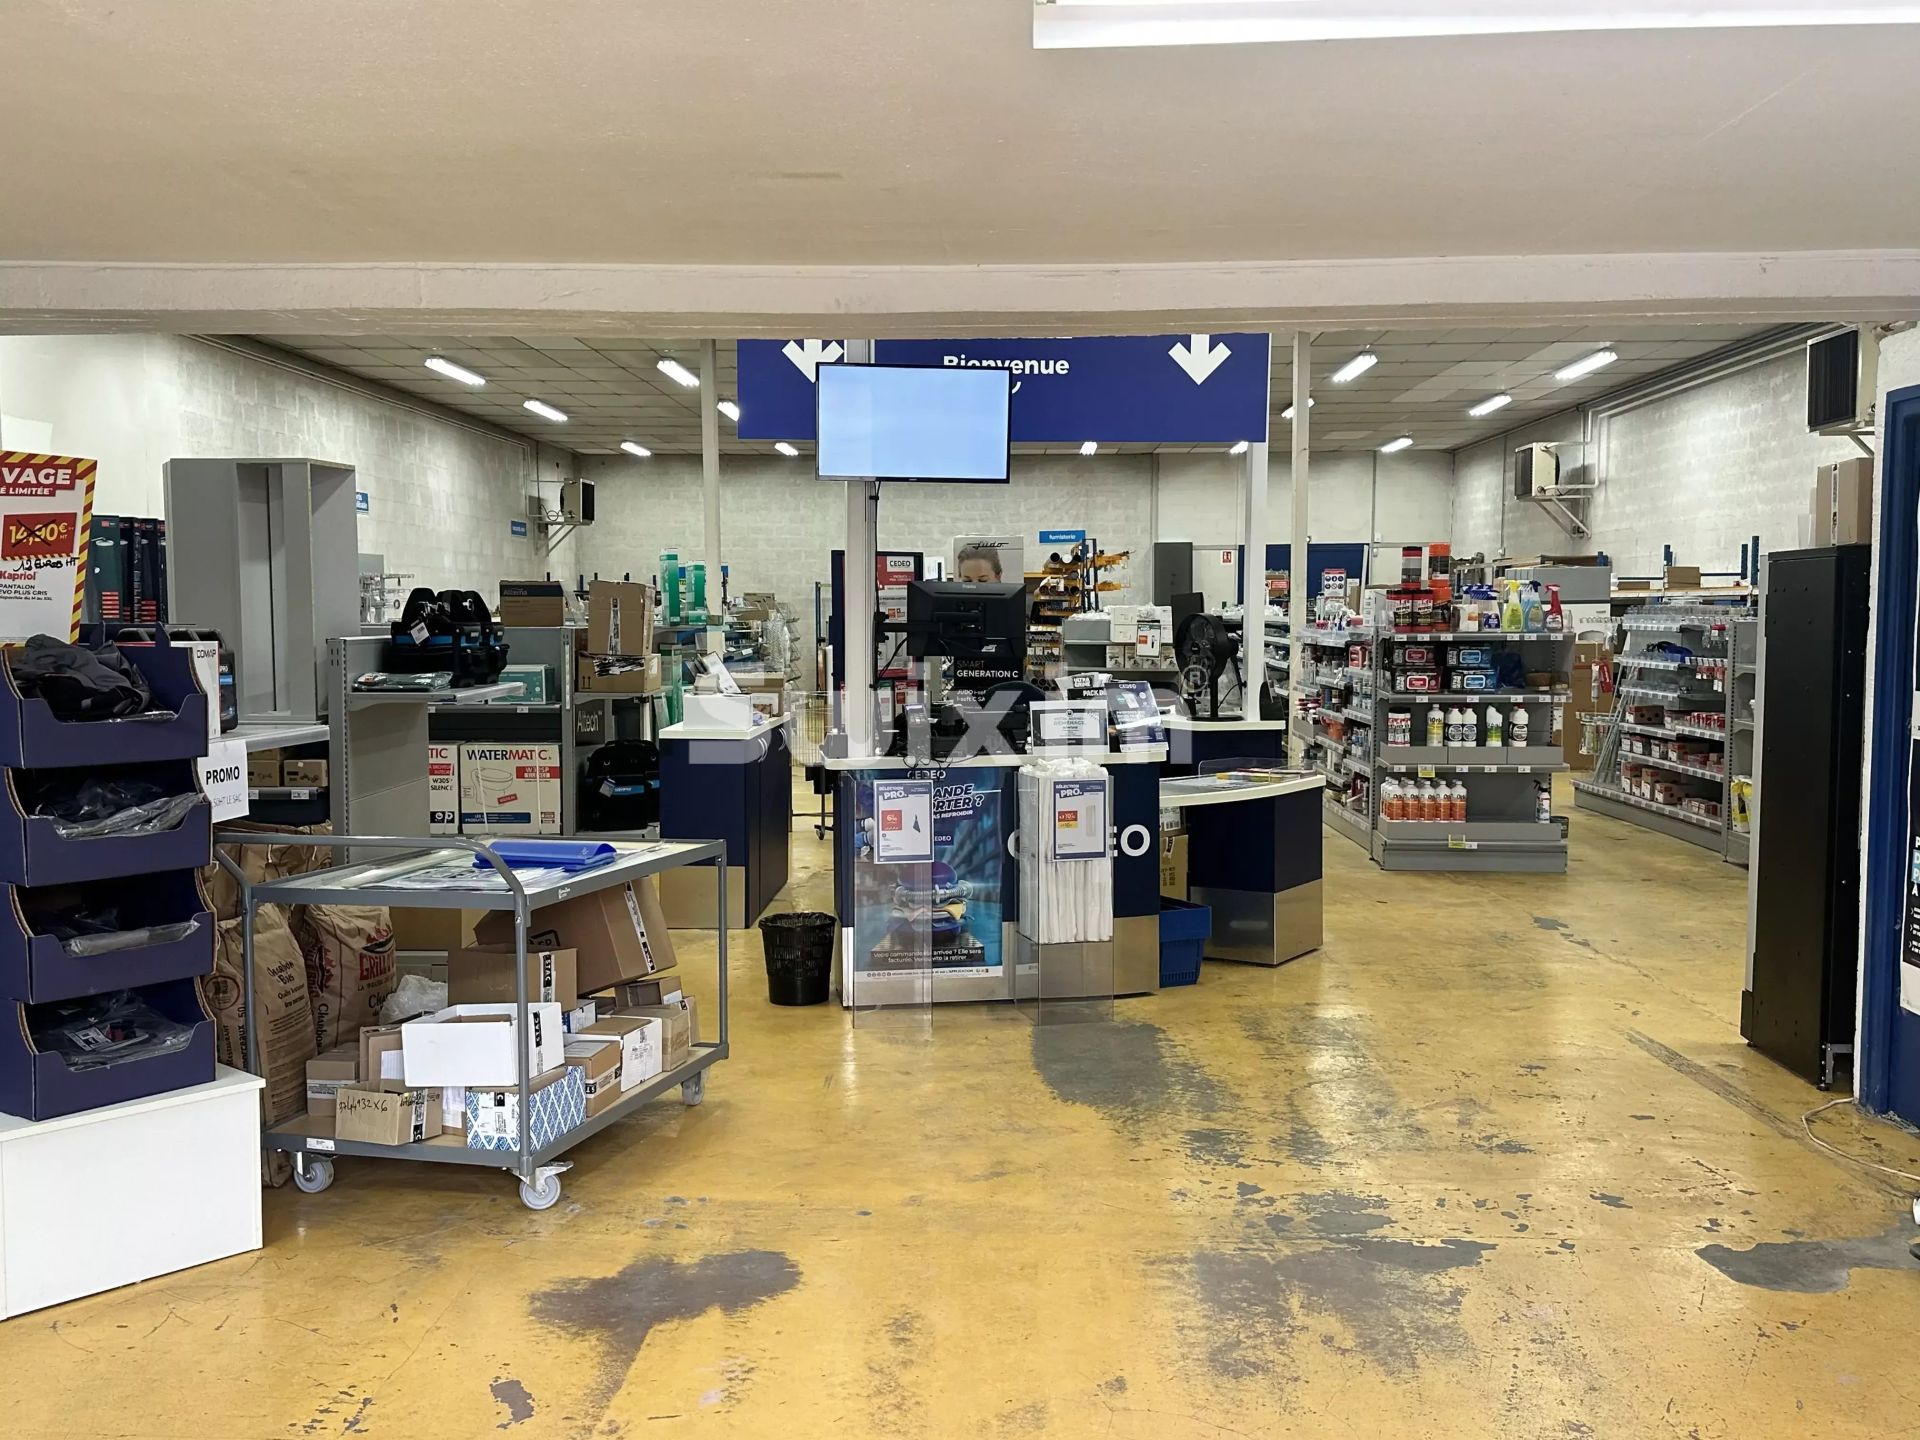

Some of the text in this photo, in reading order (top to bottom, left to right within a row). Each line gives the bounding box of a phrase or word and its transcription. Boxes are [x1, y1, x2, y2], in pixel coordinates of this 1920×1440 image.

[1, 467, 72, 485] VAGE
[957, 660, 985, 669] SMART
[957, 669, 1010, 678] GENERATION
[467, 749, 549, 760] WATERMATC
[205, 765, 240, 785] PROMO
